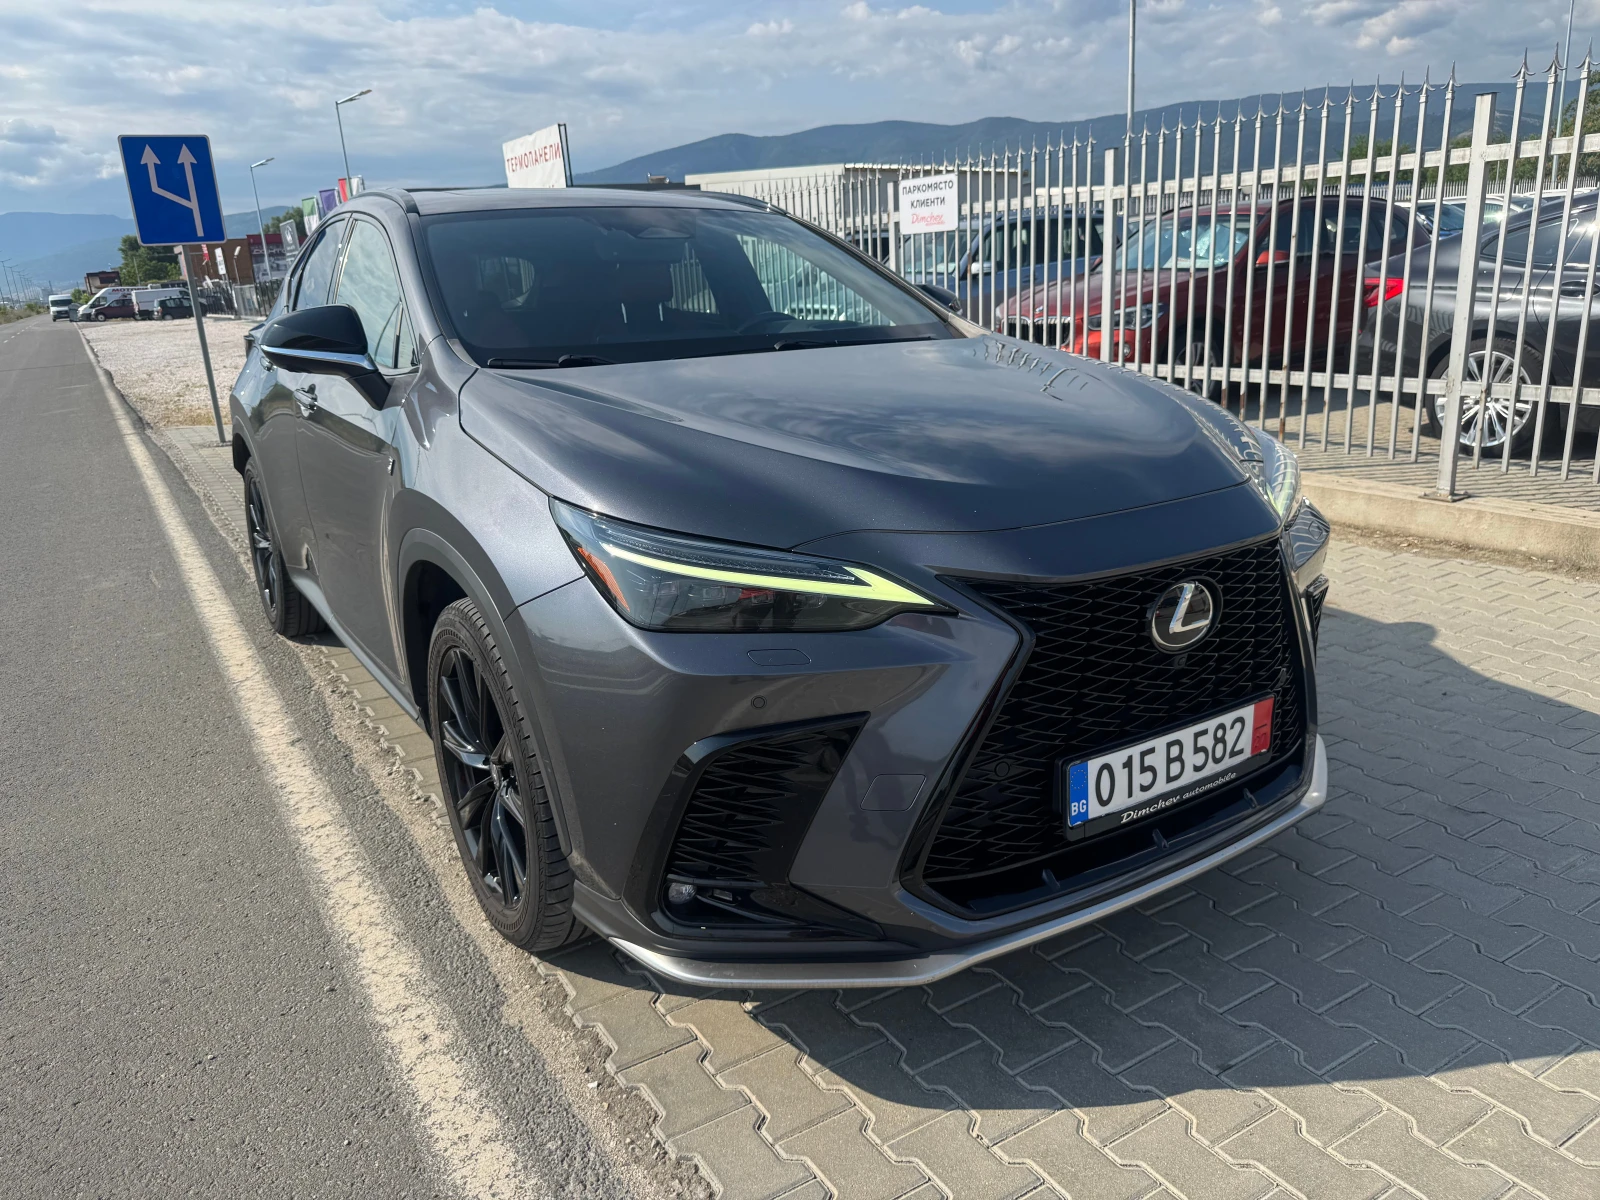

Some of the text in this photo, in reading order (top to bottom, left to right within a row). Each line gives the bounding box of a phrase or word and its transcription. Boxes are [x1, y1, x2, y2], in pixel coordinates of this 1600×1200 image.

[507, 142, 561, 173] ТЕРМОПАНЕЛИ
[902, 180, 954, 196] ПАРКОМЯСТО
[910, 196, 946, 209] КЛИЕНТИ
[1071, 716, 1246, 816] BG 015B582
[1120, 772, 1237, 824] Dimchev automobile
